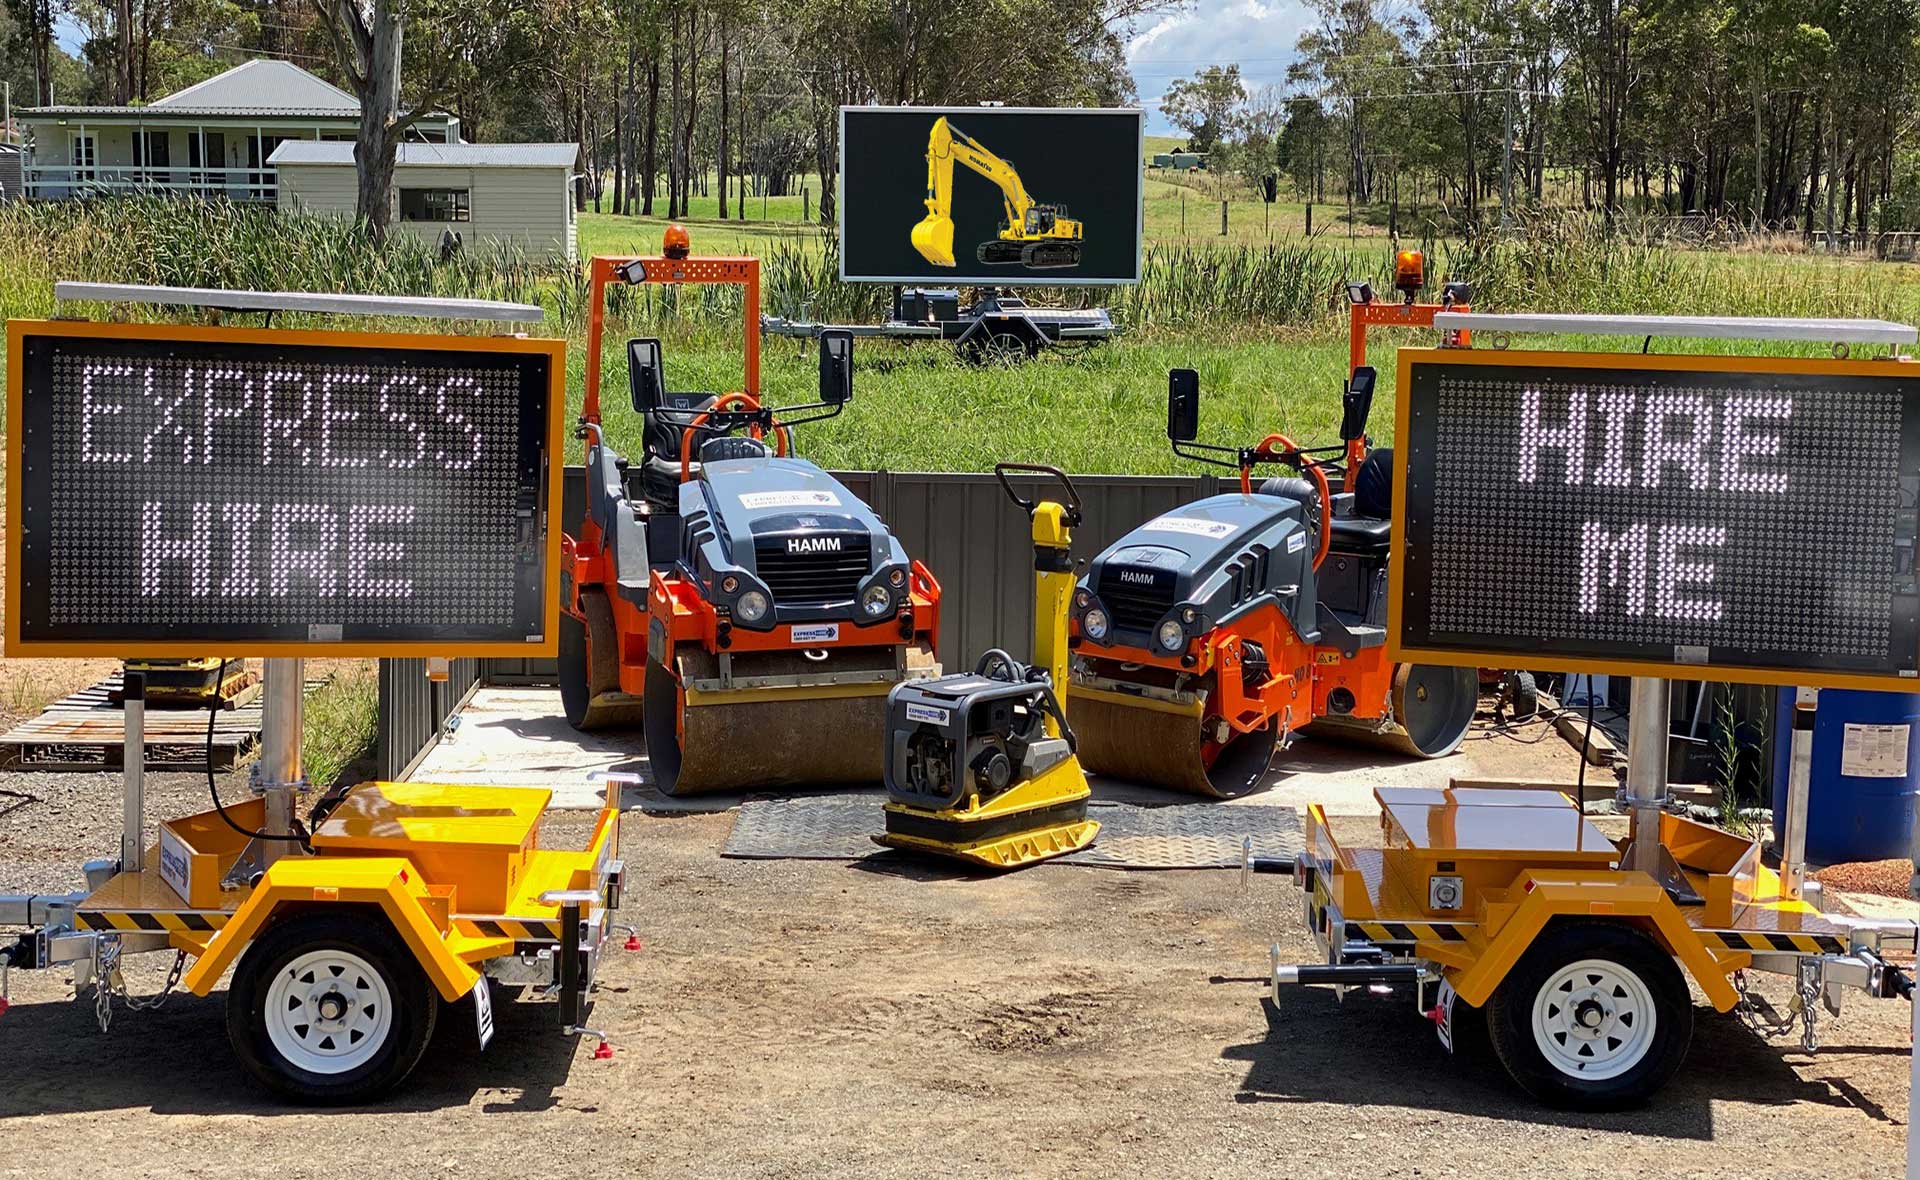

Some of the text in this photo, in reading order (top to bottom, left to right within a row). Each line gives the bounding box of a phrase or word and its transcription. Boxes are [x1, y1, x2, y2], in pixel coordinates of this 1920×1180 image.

[82, 365, 482, 469] EXPRESS
[1518, 390, 1792, 494] HIRE
[141, 501, 415, 598] HIRE
[787, 537, 841, 553] HAMM
[1120, 571, 1154, 585] HAMM
[1578, 521, 1726, 621] ME
